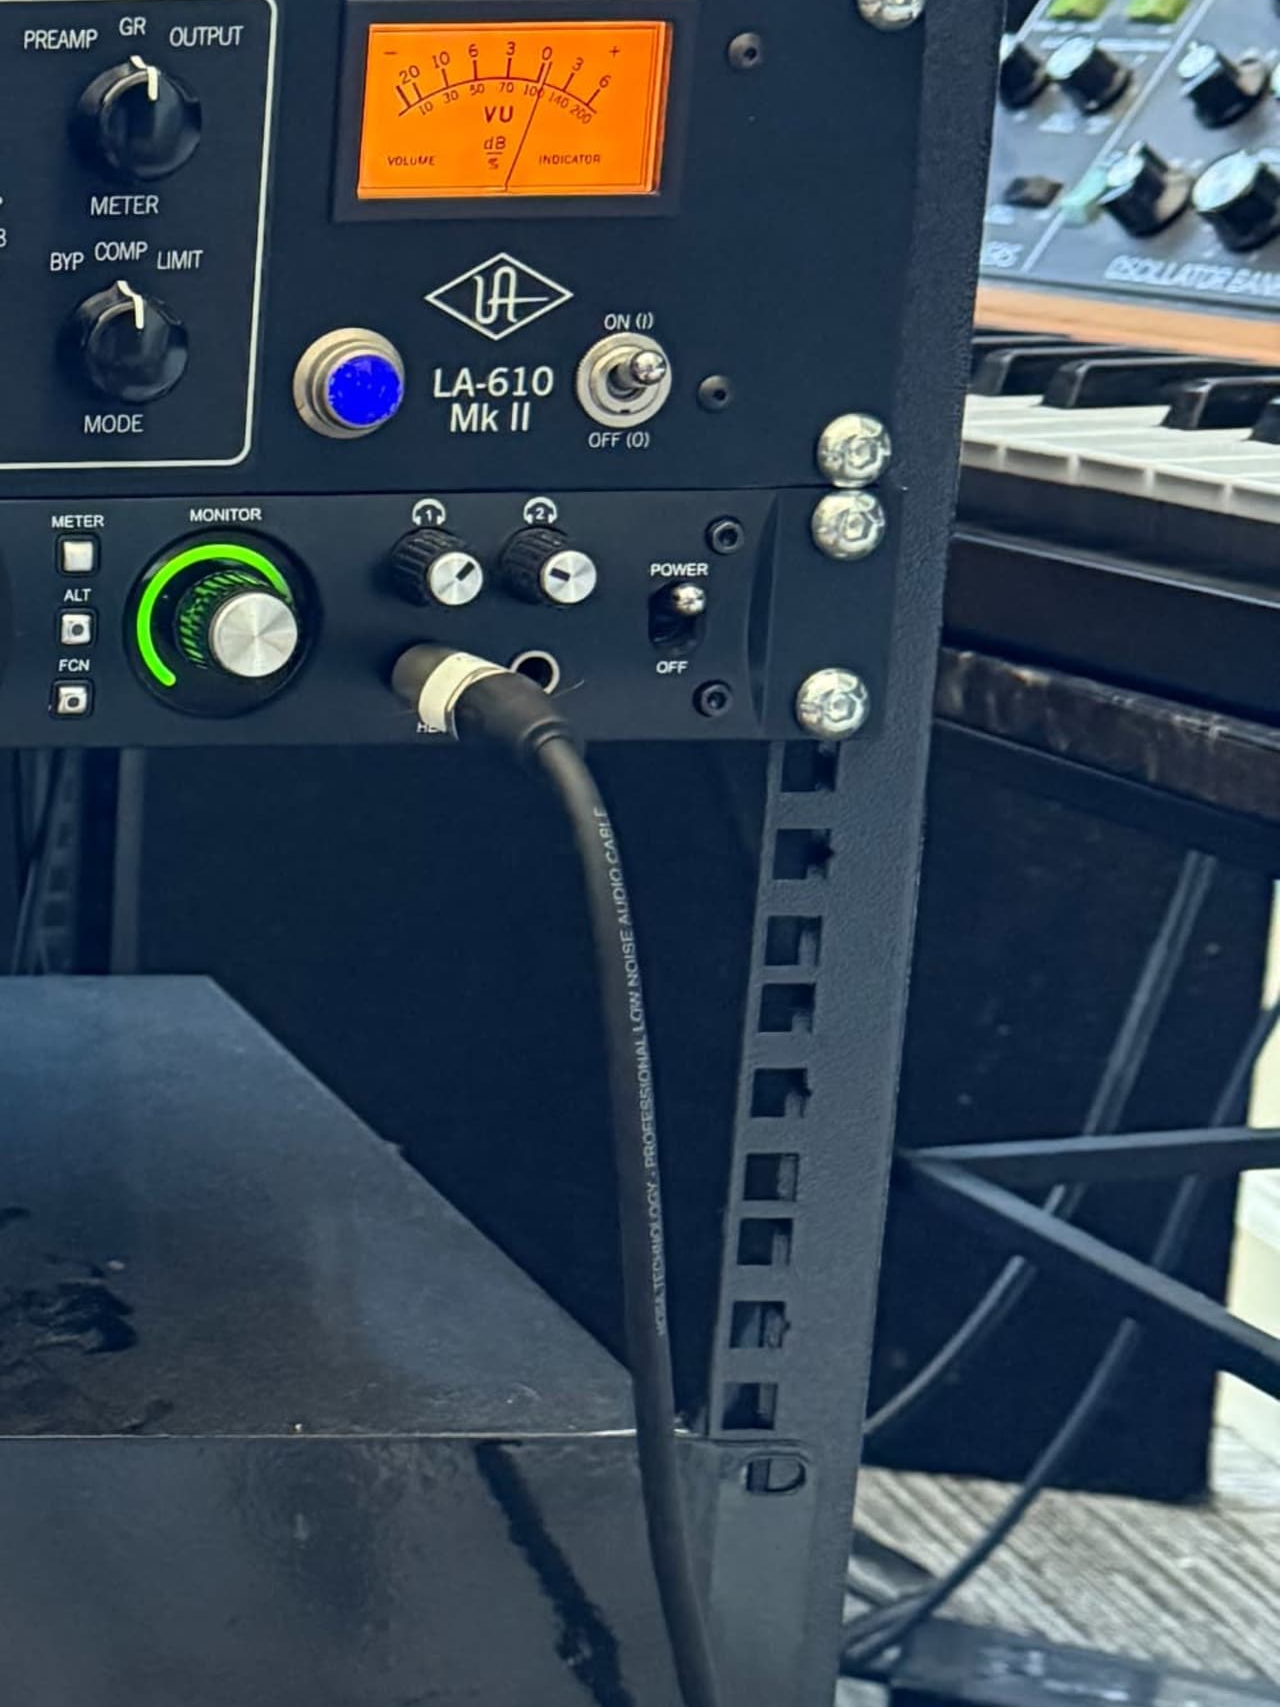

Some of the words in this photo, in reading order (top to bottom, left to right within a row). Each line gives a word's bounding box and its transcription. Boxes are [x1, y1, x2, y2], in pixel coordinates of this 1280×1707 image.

[118, 16, 147, 36] GR
[23, 28, 99, 50] PREAMP
[169, 25, 244, 47] OUTPUT
[469, 44, 478, 58] 6
[506, 42, 516, 55] 3
[542, 46, 552, 61] 0
[432, 51, 450, 68] 10
[572, 57, 584, 72] 3
[400, 65, 420, 85] 20
[599, 75, 611, 88] 6
[469, 84, 485, 94] 50
[499, 83, 514, 93] 70
[442, 91, 459, 104] 30
[420, 102, 434, 116] 10
[485, 106, 513, 122] VU
[484, 136, 506, 150] dB
[388, 156, 435, 166] VOLUME
[539, 155, 600, 165] INDICATOR
[90, 194, 160, 216] METER
[94, 240, 149, 262] COMP
[49, 251, 85, 272] BYP
[156, 249, 204, 270] LIMIT
[603, 313, 631, 331] ON
[433, 365, 554, 398] LA-610
[83, 413, 144, 434] MODE
[450, 402, 499, 433] Mk
[510, 401, 531, 432] II
[588, 431, 622, 448] OFF
[51, 514, 105, 529] METER
[189, 507, 262, 522] MONITOR
[650, 562, 709, 577] POWER
[63, 588, 92, 602] ALT
[58, 658, 90, 672] FCN
[655, 660, 689, 674] OFF
[609, 868, 631, 924] AUDIO
[620, 930, 641, 987] NOISE
[630, 992, 644, 1033] LOW
[638, 1035, 658, 1168] PROFESSIONAL
